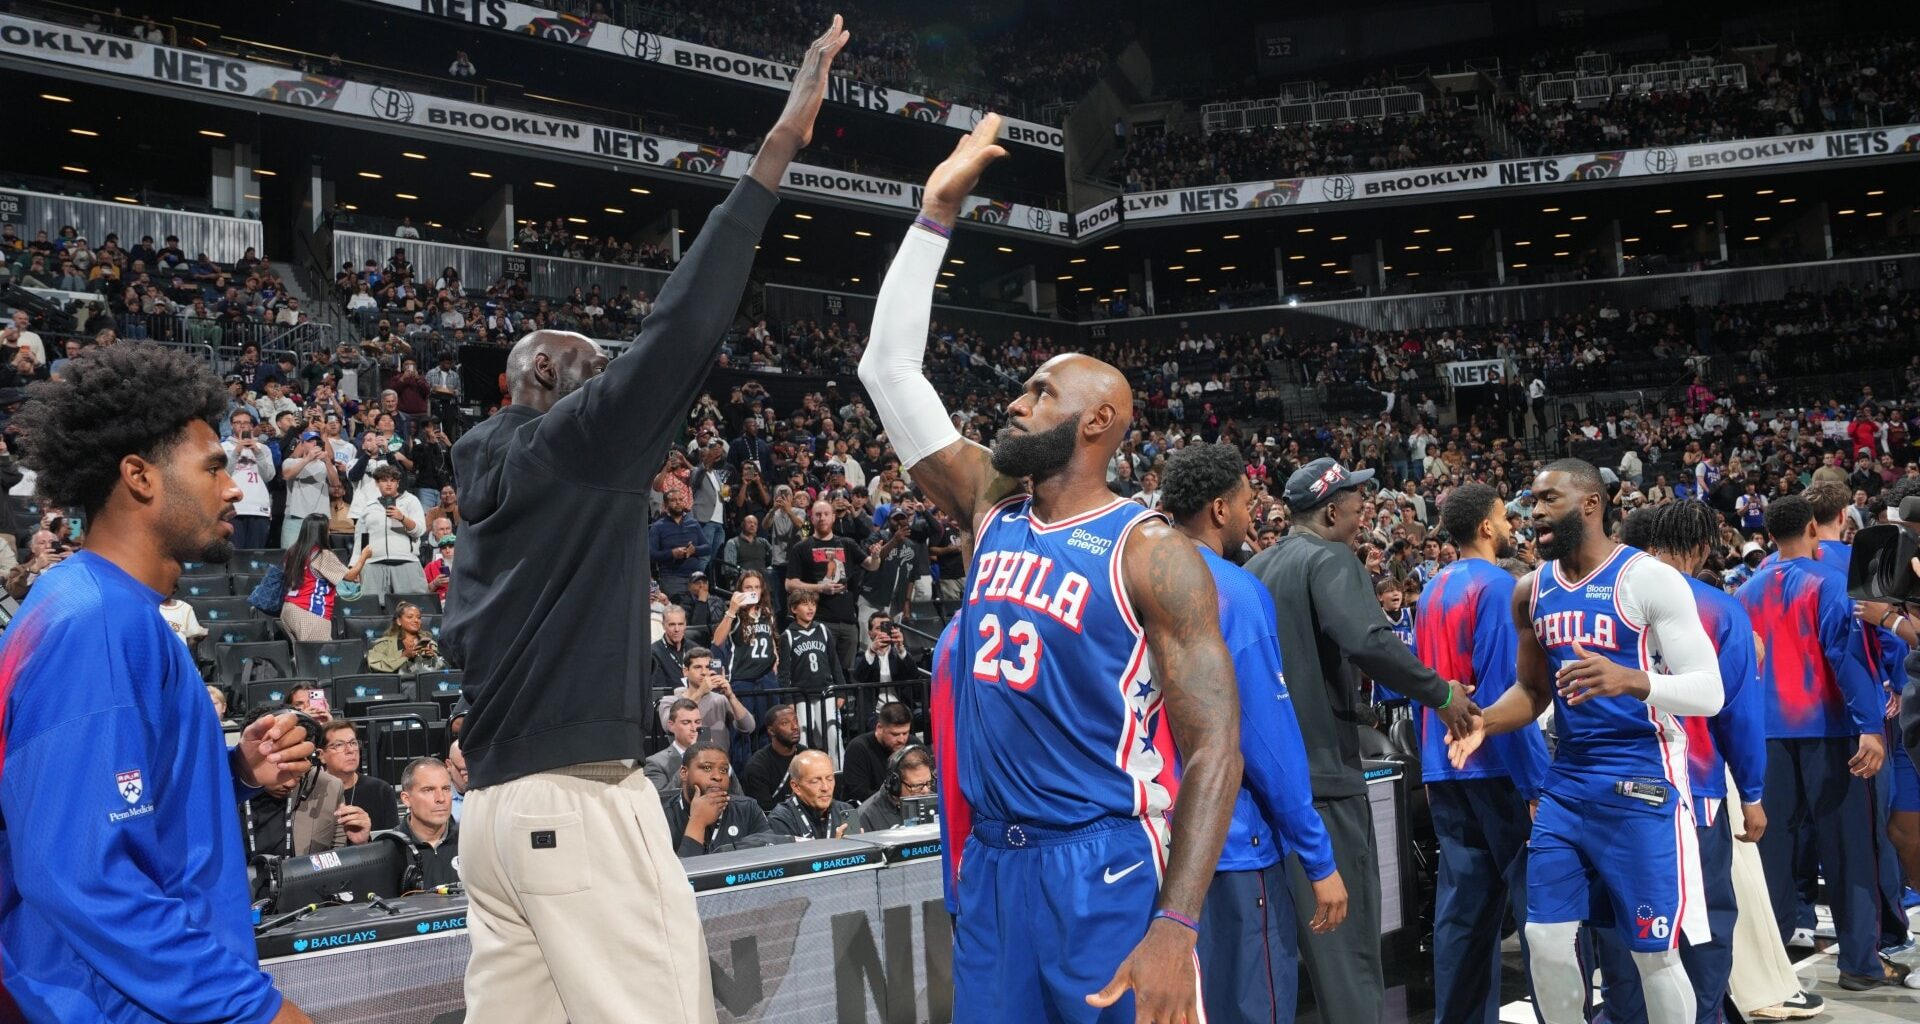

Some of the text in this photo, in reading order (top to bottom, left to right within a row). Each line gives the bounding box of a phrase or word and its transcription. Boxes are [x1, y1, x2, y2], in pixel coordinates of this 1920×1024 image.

[1267, 45, 1291, 56] 212
[153, 48, 248, 93] NETS
[675, 51, 889, 113] BROOKLY NETS
[428, 108, 659, 163] BROOKLYN NETS
[1688, 131, 1889, 168] BROOKLYN NETS
[789, 172, 902, 197] BROOKLYN
[1365, 160, 1560, 195] BROOKLYN NETS
[1180, 188, 1239, 213] NETS
[1453, 364, 1500, 384] NETS
[248, 471, 260, 484] 21
[1066, 537, 1108, 556] energy
[1071, 528, 1113, 547] Bloom
[969, 550, 1092, 635] PHILA
[1585, 592, 1612, 600] energy
[1586, 584, 1613, 593] Bloom
[1533, 610, 1620, 652] PHILA
[750, 637, 769, 659] 22
[793, 640, 826, 656] BROOKLYN
[973, 613, 1043, 692] 23
[808, 652, 819, 672] 8
[1370, 768, 1393, 778] BARCLAYS
[109, 804, 154, 822] Penn Medicin
[911, 844, 942, 855] BARCLA
[320, 852, 342, 869] NBA
[823, 855, 866, 870] BARCLAYS
[737, 868, 784, 883] BARCLAYS
[433, 917, 468, 931] BARC
[1636, 915, 1669, 939] 76
[311, 930, 377, 950] BARCLAYS
